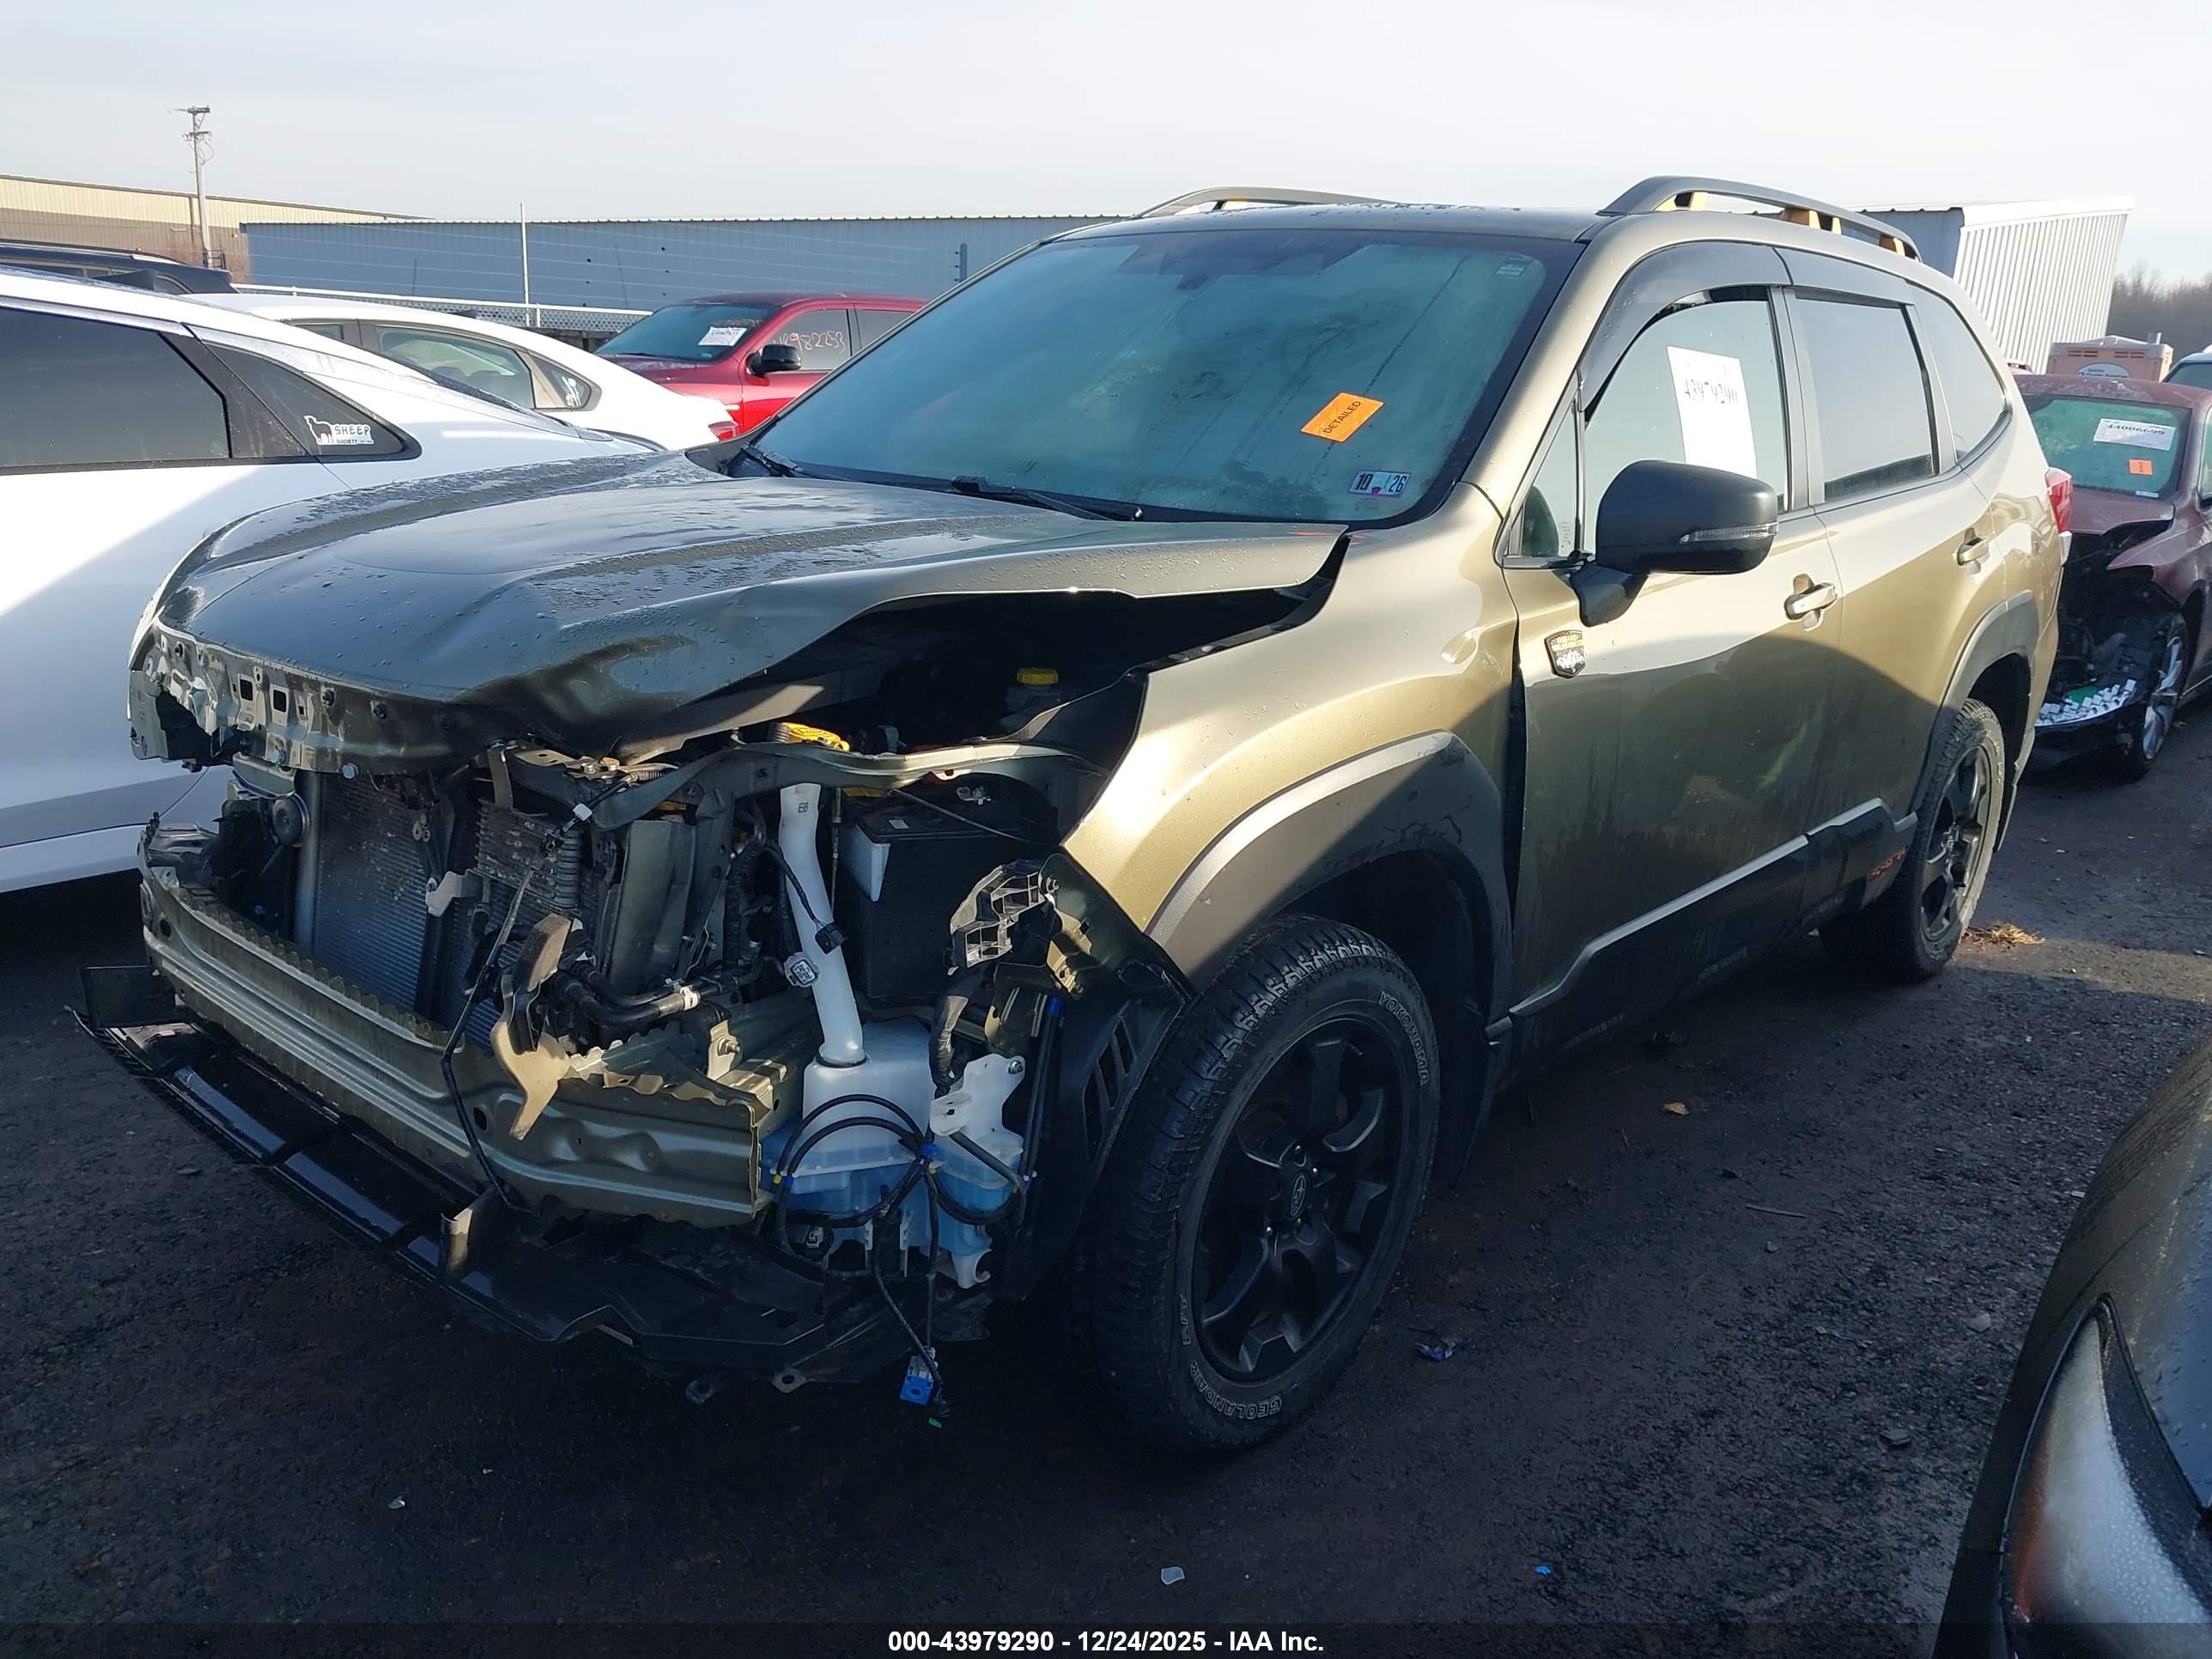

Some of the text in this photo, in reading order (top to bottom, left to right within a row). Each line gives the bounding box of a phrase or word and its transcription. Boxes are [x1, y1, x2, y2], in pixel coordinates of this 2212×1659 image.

[334, 425, 370, 435] SHEEP
[1322, 401, 1361, 434] DETAILED
[1356, 473, 1407, 493] 10 26
[1378, 990, 1429, 1086] YOKOHAMA
[1190, 1361, 1283, 1419] GEOLANDAR
